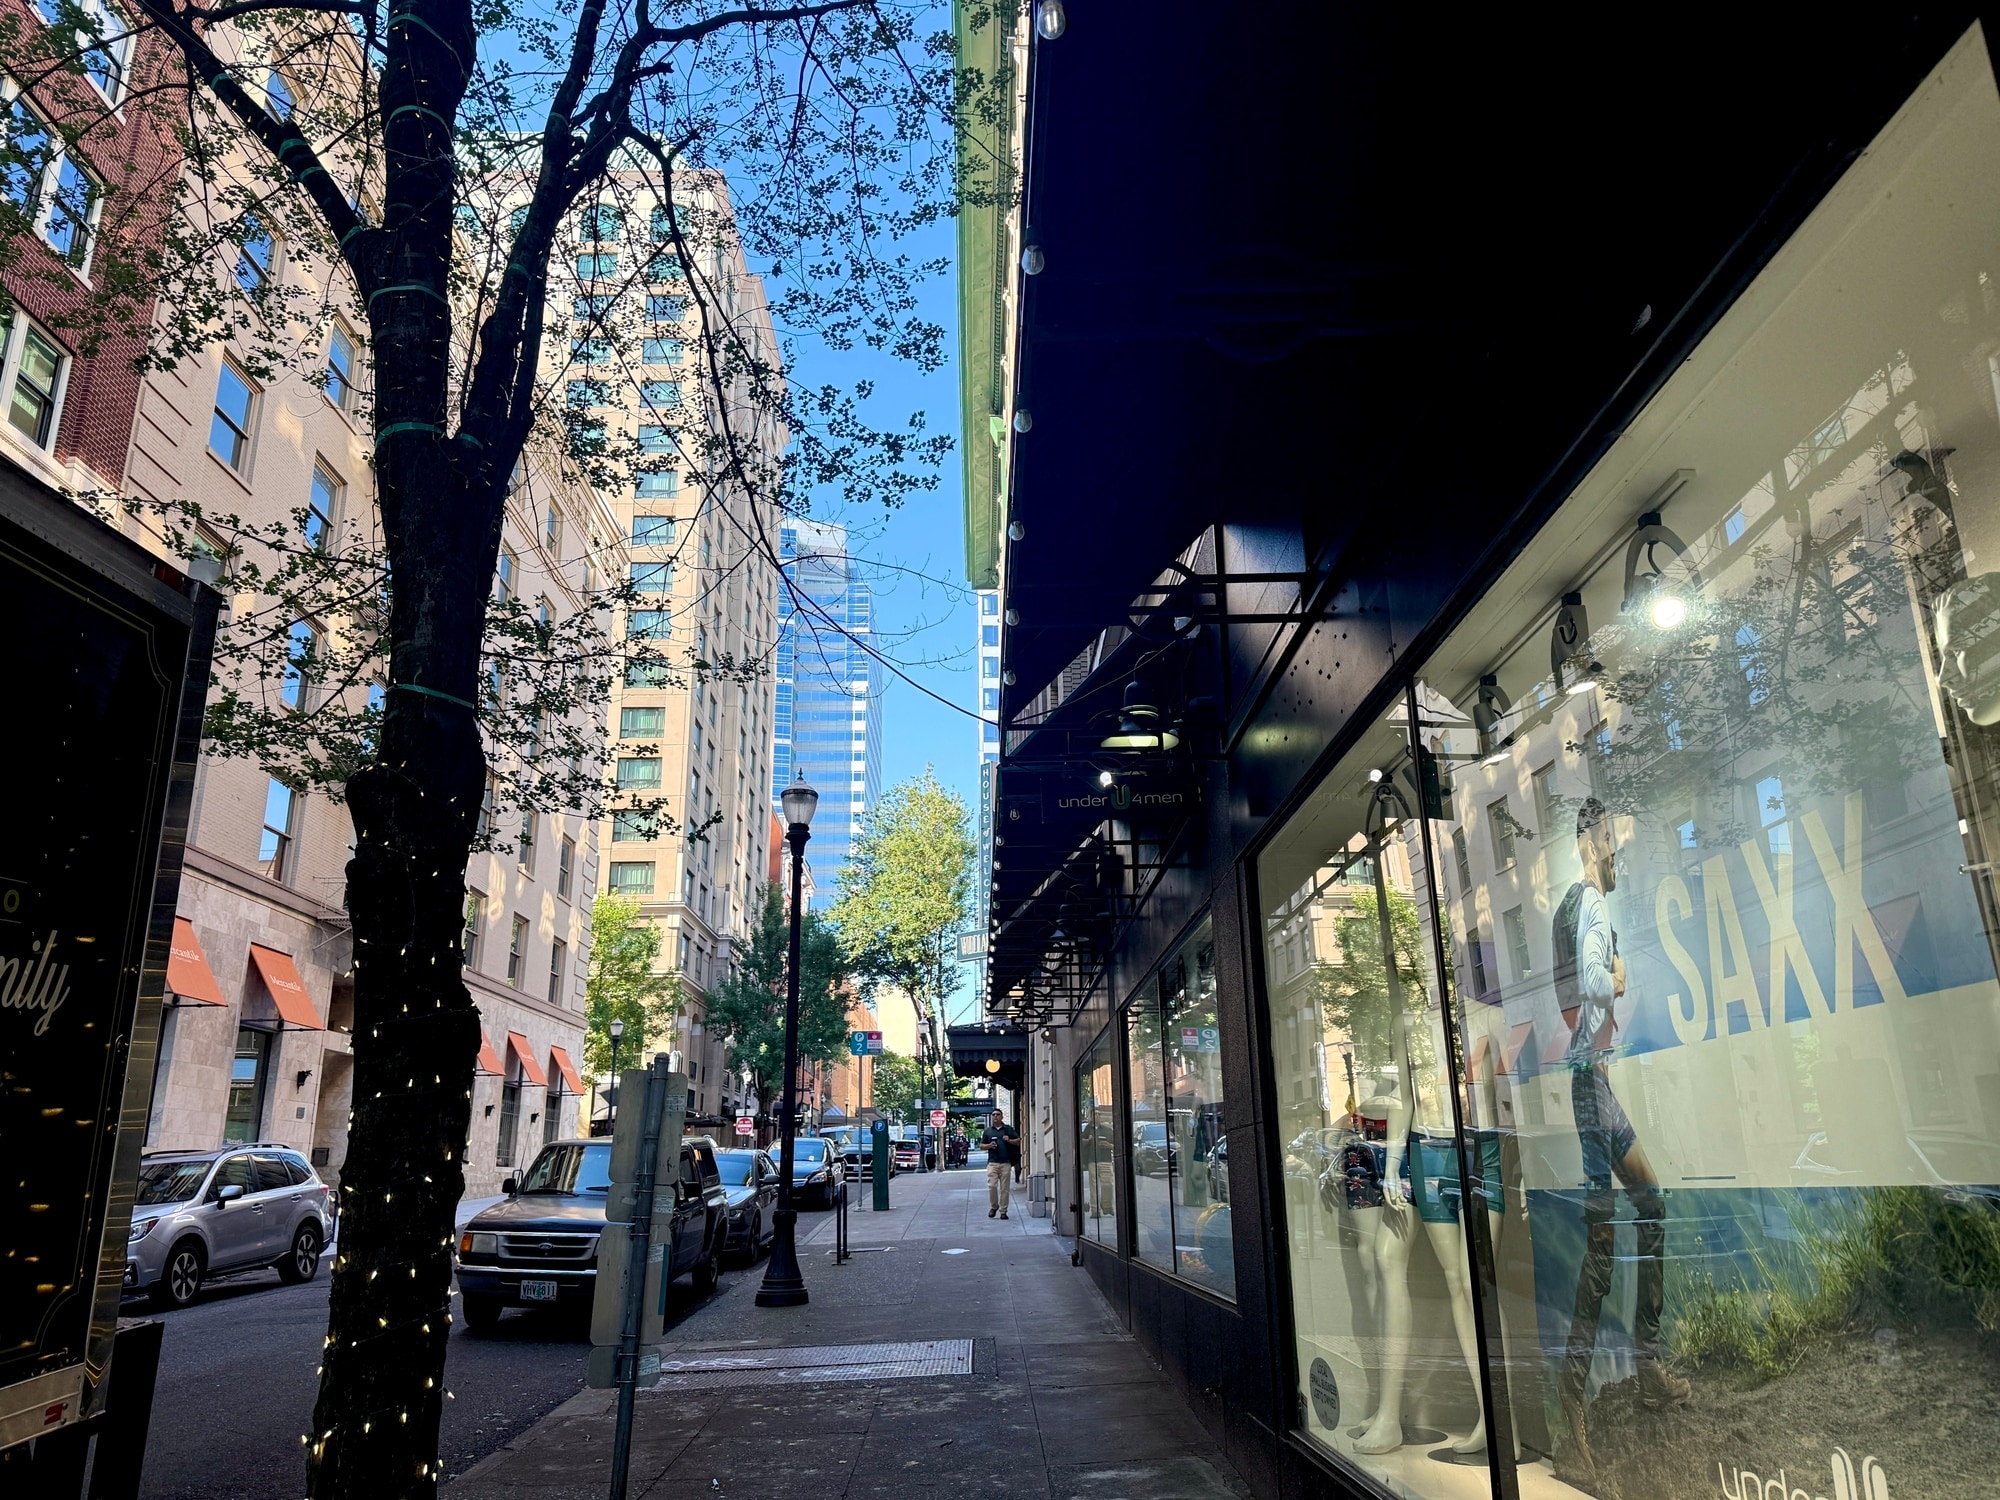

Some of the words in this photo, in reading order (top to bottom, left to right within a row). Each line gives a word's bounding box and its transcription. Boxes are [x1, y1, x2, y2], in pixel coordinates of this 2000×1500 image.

[1058, 795, 1108, 809] under
[1132, 791, 1183, 805] 4men
[1655, 788, 1908, 1046] SAXX
[856, 1043, 863, 1052] 2
[1718, 1462, 1830, 1500] und
